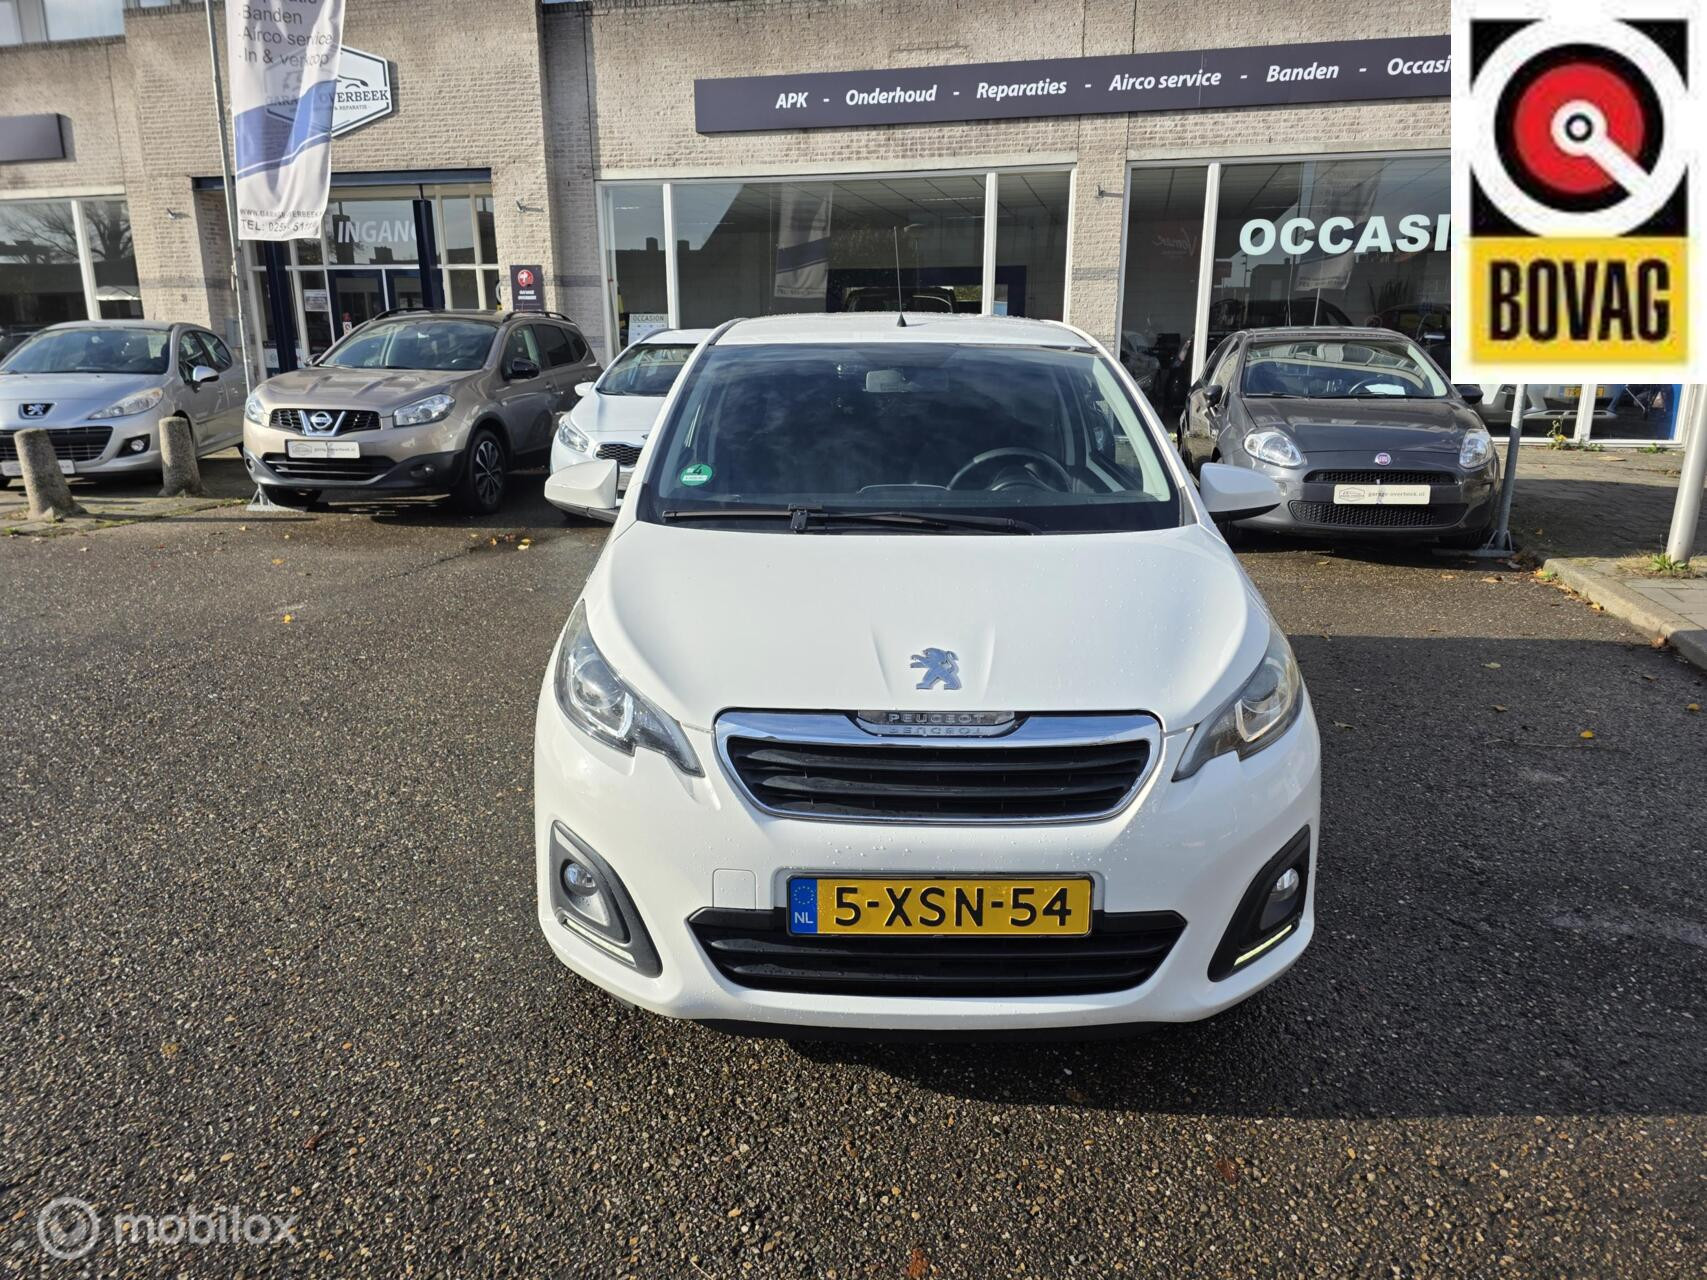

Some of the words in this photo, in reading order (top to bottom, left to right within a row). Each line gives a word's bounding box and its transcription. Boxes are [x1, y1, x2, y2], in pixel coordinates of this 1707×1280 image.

[242, 4, 303, 24] Banden
[243, 26, 282, 44] Airco
[244, 48, 258, 62] In
[263, 49, 273, 64] &
[775, 92, 808, 109] APK
[845, 85, 938, 106] Onderhoud
[976, 78, 1067, 102] Reparaties
[1108, 73, 1156, 92] Airco
[1158, 69, 1222, 89] service
[1266, 61, 1339, 83] Banden
[240, 219, 265, 231] TEL:
[1239, 213, 1451, 256] OCCASI
[888, 713, 985, 723] PEUGEOT
[834, 886, 1072, 927] 5-XSN-54
[794, 911, 814, 924] NL
